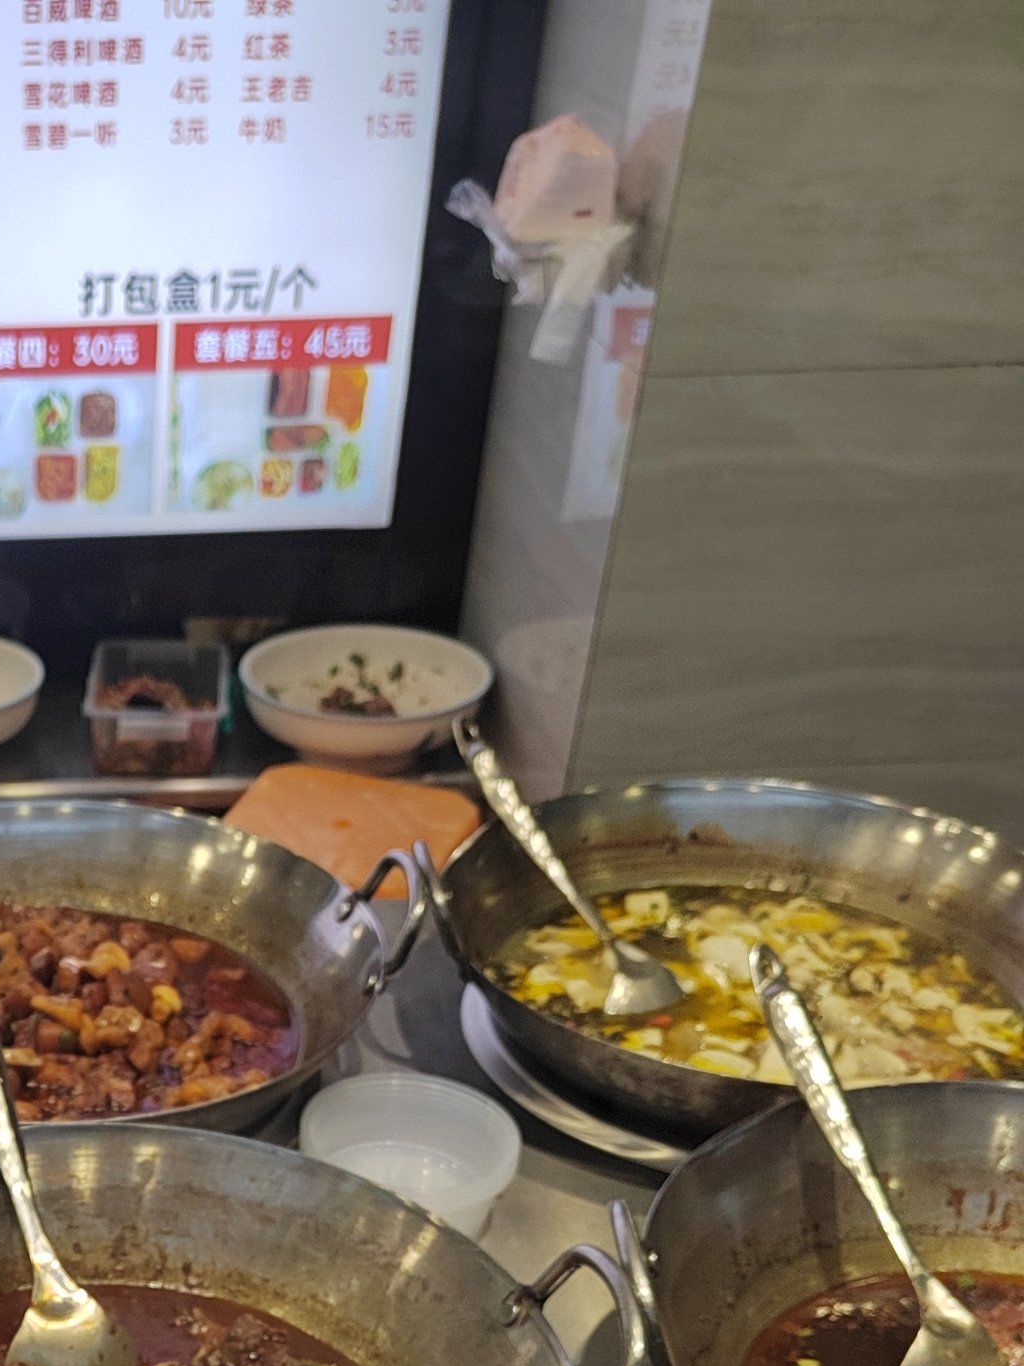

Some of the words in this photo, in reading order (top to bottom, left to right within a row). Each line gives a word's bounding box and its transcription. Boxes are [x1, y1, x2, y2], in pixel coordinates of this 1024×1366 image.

[163, 0, 212, 20] 10元
[20, 36, 144, 66] 三得利啤酒
[172, 32, 212, 62] 4元
[243, 32, 290, 62] 红茶
[383, 28, 422, 56] 3元
[22, 78, 120, 110] 雪花啤酒
[170, 76, 210, 104] 4元
[240, 74, 312, 103] 王老吉
[379, 70, 419, 97] 4元
[169, 117, 208, 146] 3元
[238, 115, 286, 144] 牛奶
[364, 111, 416, 139] 15元
[78, 266, 320, 316] 打包盒1元/个
